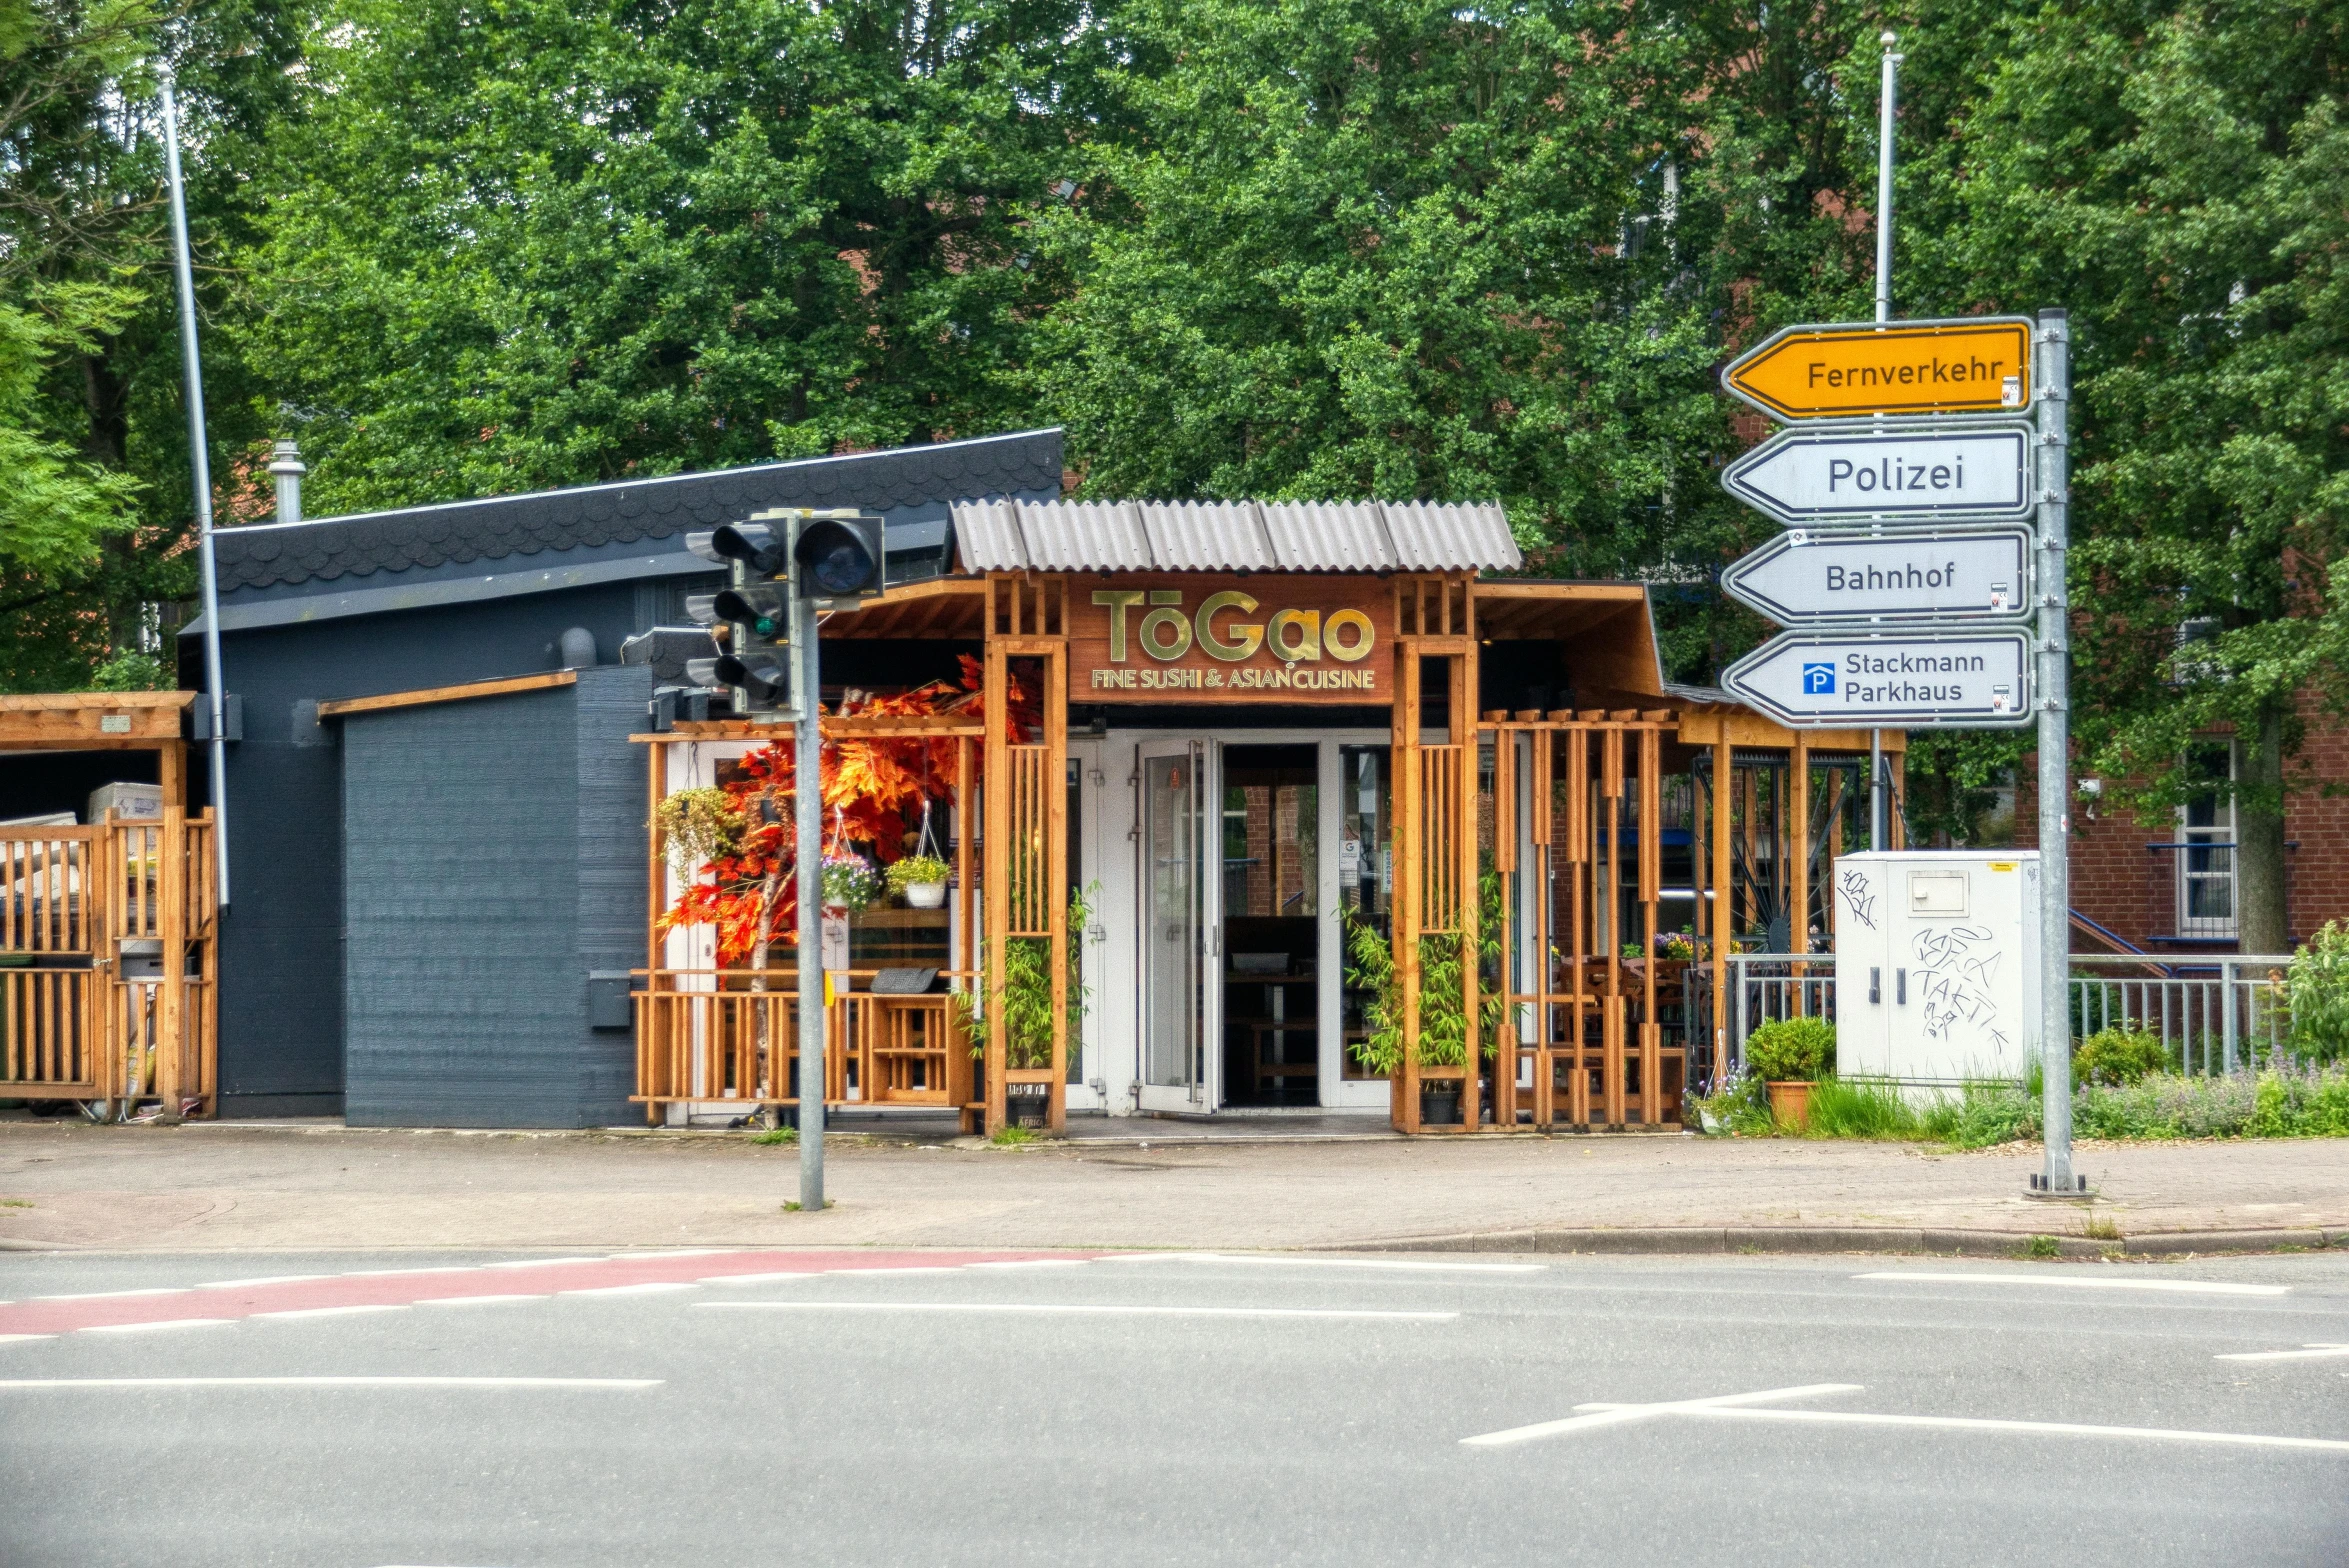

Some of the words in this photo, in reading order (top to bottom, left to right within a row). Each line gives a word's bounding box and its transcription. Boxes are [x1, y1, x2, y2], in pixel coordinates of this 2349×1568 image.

[1808, 355, 2004, 389] Fernverkehr
[1829, 455, 1963, 492] Polizei
[1826, 561, 1955, 591] Bahnhof
[1845, 652, 1984, 674] Stackmann
[1092, 669, 1137, 688] FINE
[1140, 668, 1202, 689] SUSHI
[1204, 668, 1225, 687] &
[1227, 668, 1291, 688] ASIAN
[1292, 669, 1375, 689] CUISINE
[1813, 672, 1828, 693] P
[1845, 681, 1962, 703] Parkhaus
